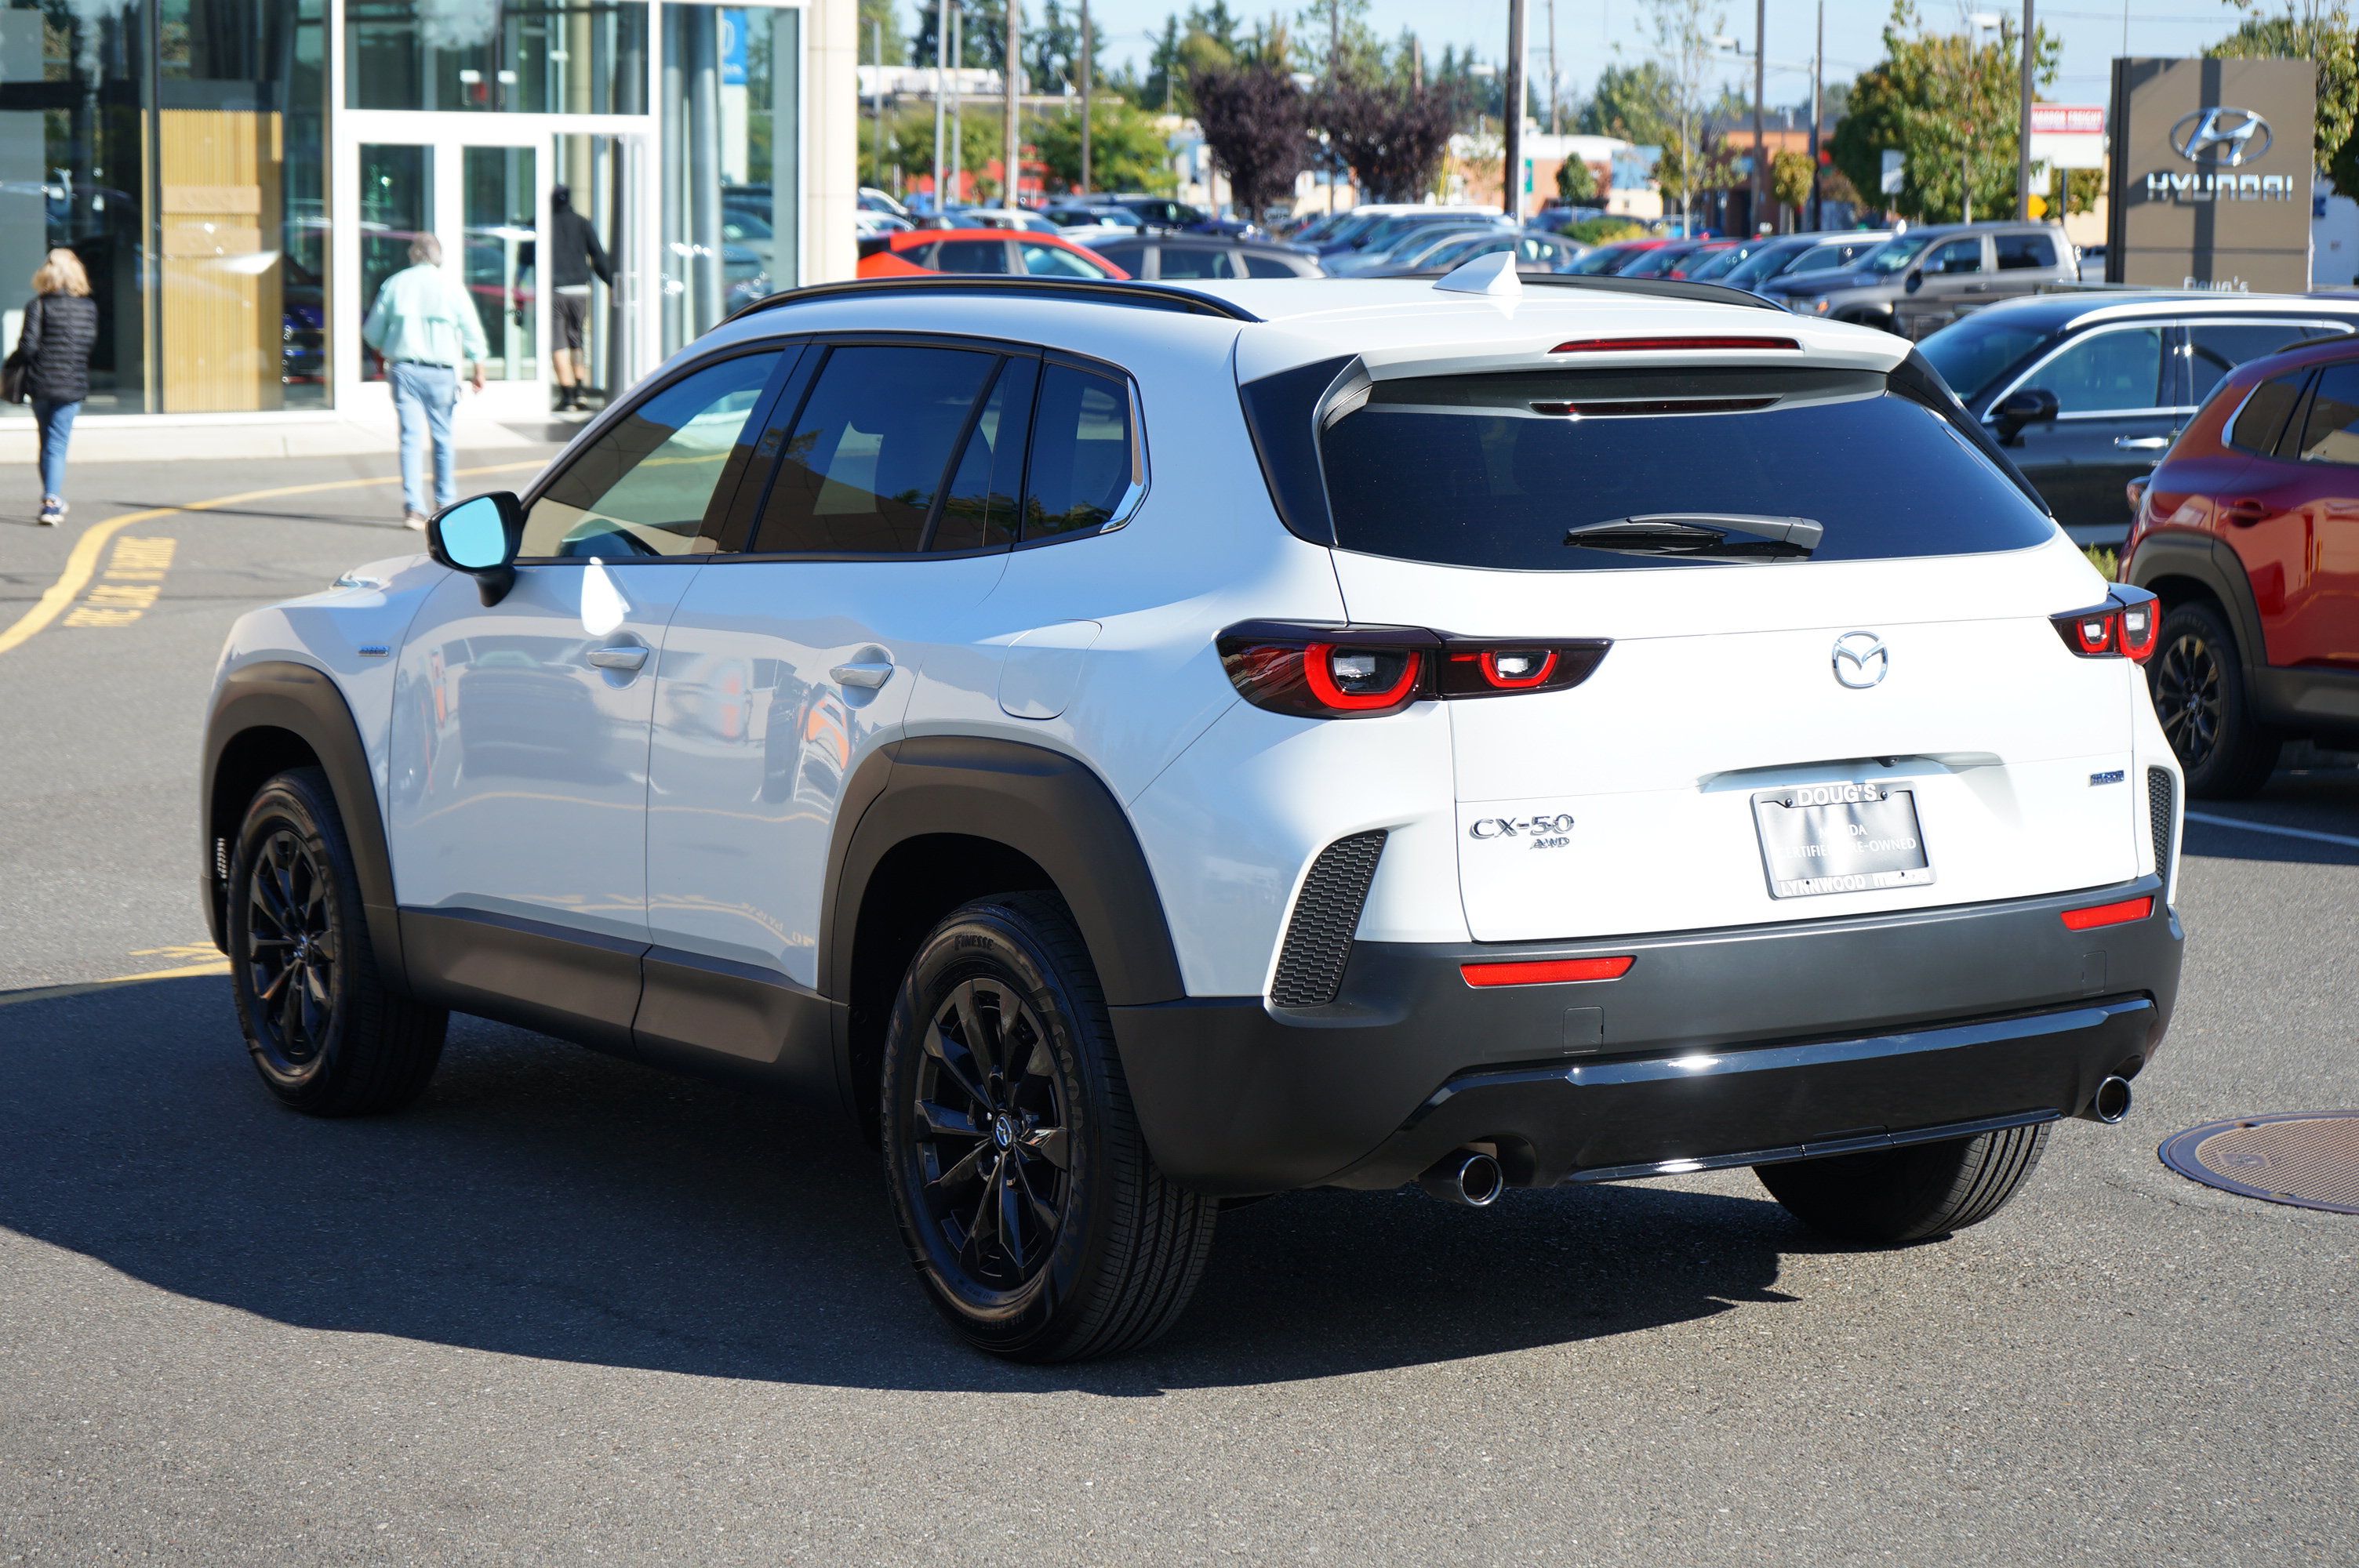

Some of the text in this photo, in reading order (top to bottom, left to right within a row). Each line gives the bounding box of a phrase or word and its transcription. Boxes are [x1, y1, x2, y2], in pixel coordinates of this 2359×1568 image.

[2147, 172, 2293, 201] HYUNDAI
[1797, 784, 1877, 806] DOUG'S
[1469, 814, 1575, 840] CX-50
[1529, 837, 1570, 850] AWD
[1779, 874, 1866, 896] LYNNWOOD
[954, 934, 994, 951] FINESSE
